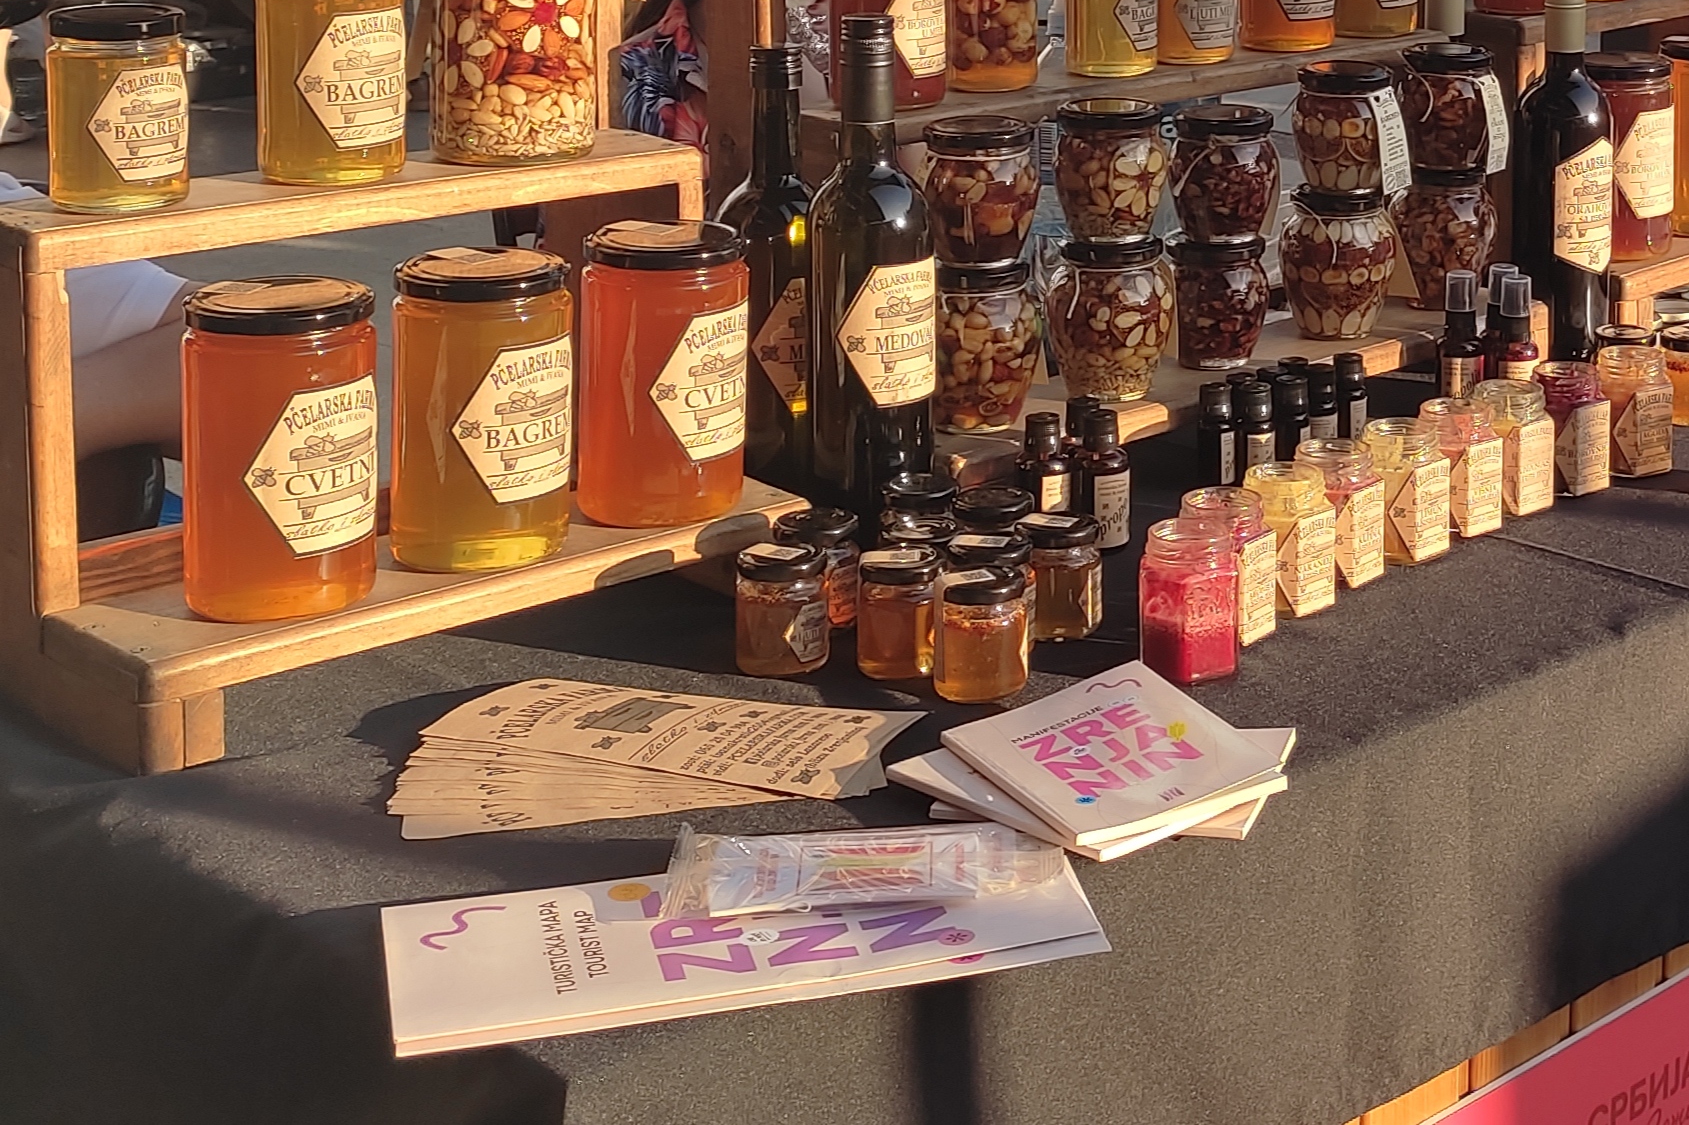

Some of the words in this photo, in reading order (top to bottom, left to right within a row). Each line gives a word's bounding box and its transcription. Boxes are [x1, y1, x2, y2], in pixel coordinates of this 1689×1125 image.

[489, 350, 553, 390] PČELARSKA
[283, 391, 352, 436] PČELARSKA
[1018, 703, 1152, 762] ZRE
[1042, 723, 1168, 781] NJA
[1067, 739, 1205, 798] NIN
[538, 900, 559, 936] MAPA
[573, 910, 595, 934] MAP
[543, 934, 578, 995] TURISTIČKA
[579, 933, 610, 979] TOURIST
